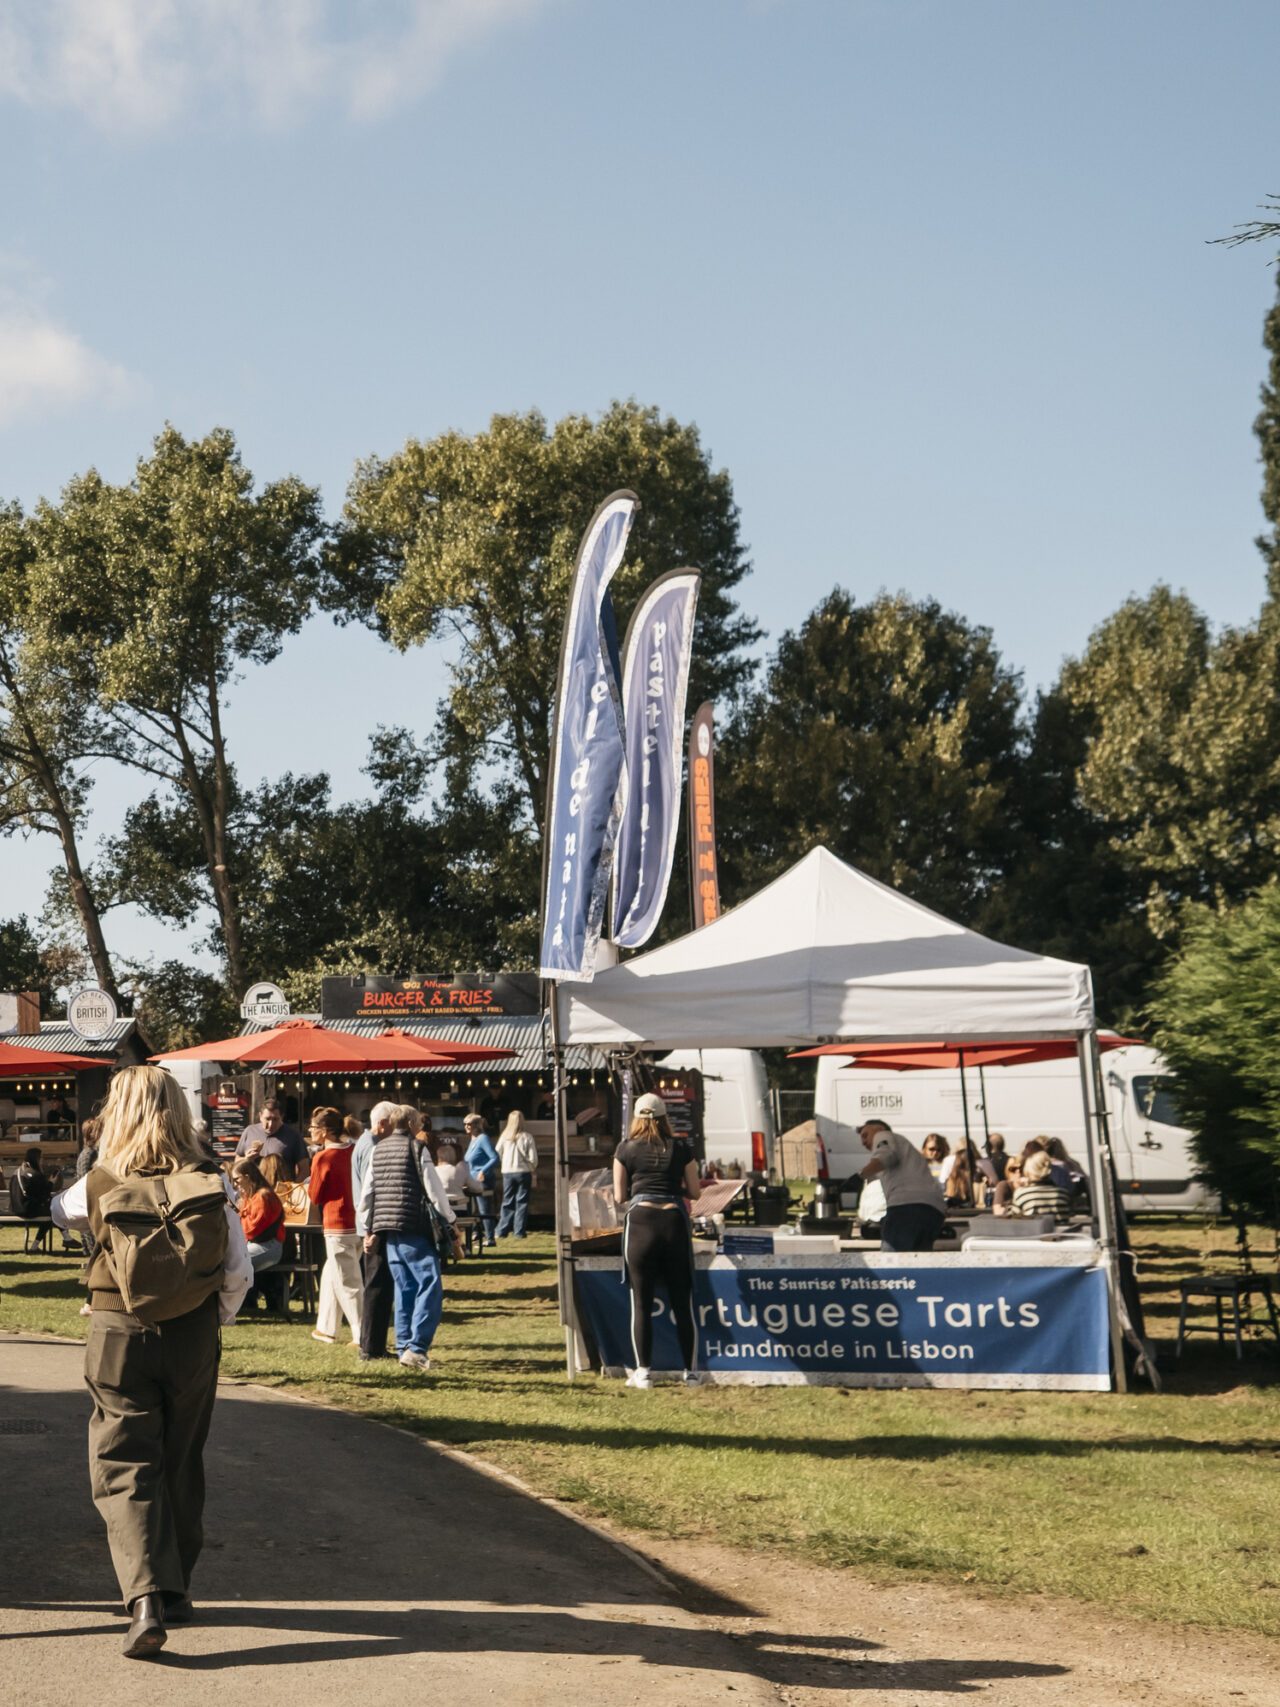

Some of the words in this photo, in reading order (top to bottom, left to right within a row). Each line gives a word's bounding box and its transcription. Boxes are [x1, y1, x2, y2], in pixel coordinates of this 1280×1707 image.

[642, 621, 667, 788] pastel
[569, 757, 590, 817] de
[694, 757, 712, 842] FRIES
[552, 831, 577, 946] nata
[363, 991, 426, 1008] BURGER
[430, 990, 443, 1006] &
[449, 989, 493, 1006] FRIES
[76, 1006, 108, 1019] BRITISH
[242, 1005, 258, 1017] THE
[260, 1003, 289, 1016] ANGUS
[860, 1095, 903, 1108] BRITISH
[747, 1277, 774, 1291] The
[778, 1277, 836, 1291] Sunrise
[841, 1276, 916, 1290] Patisserie
[650, 1297, 900, 1334] Prtuguese
[916, 1296, 1040, 1328] Tarts
[704, 1338, 845, 1359] Handmade
[854, 1340, 876, 1359] in
[886, 1339, 974, 1360] Lisbon
